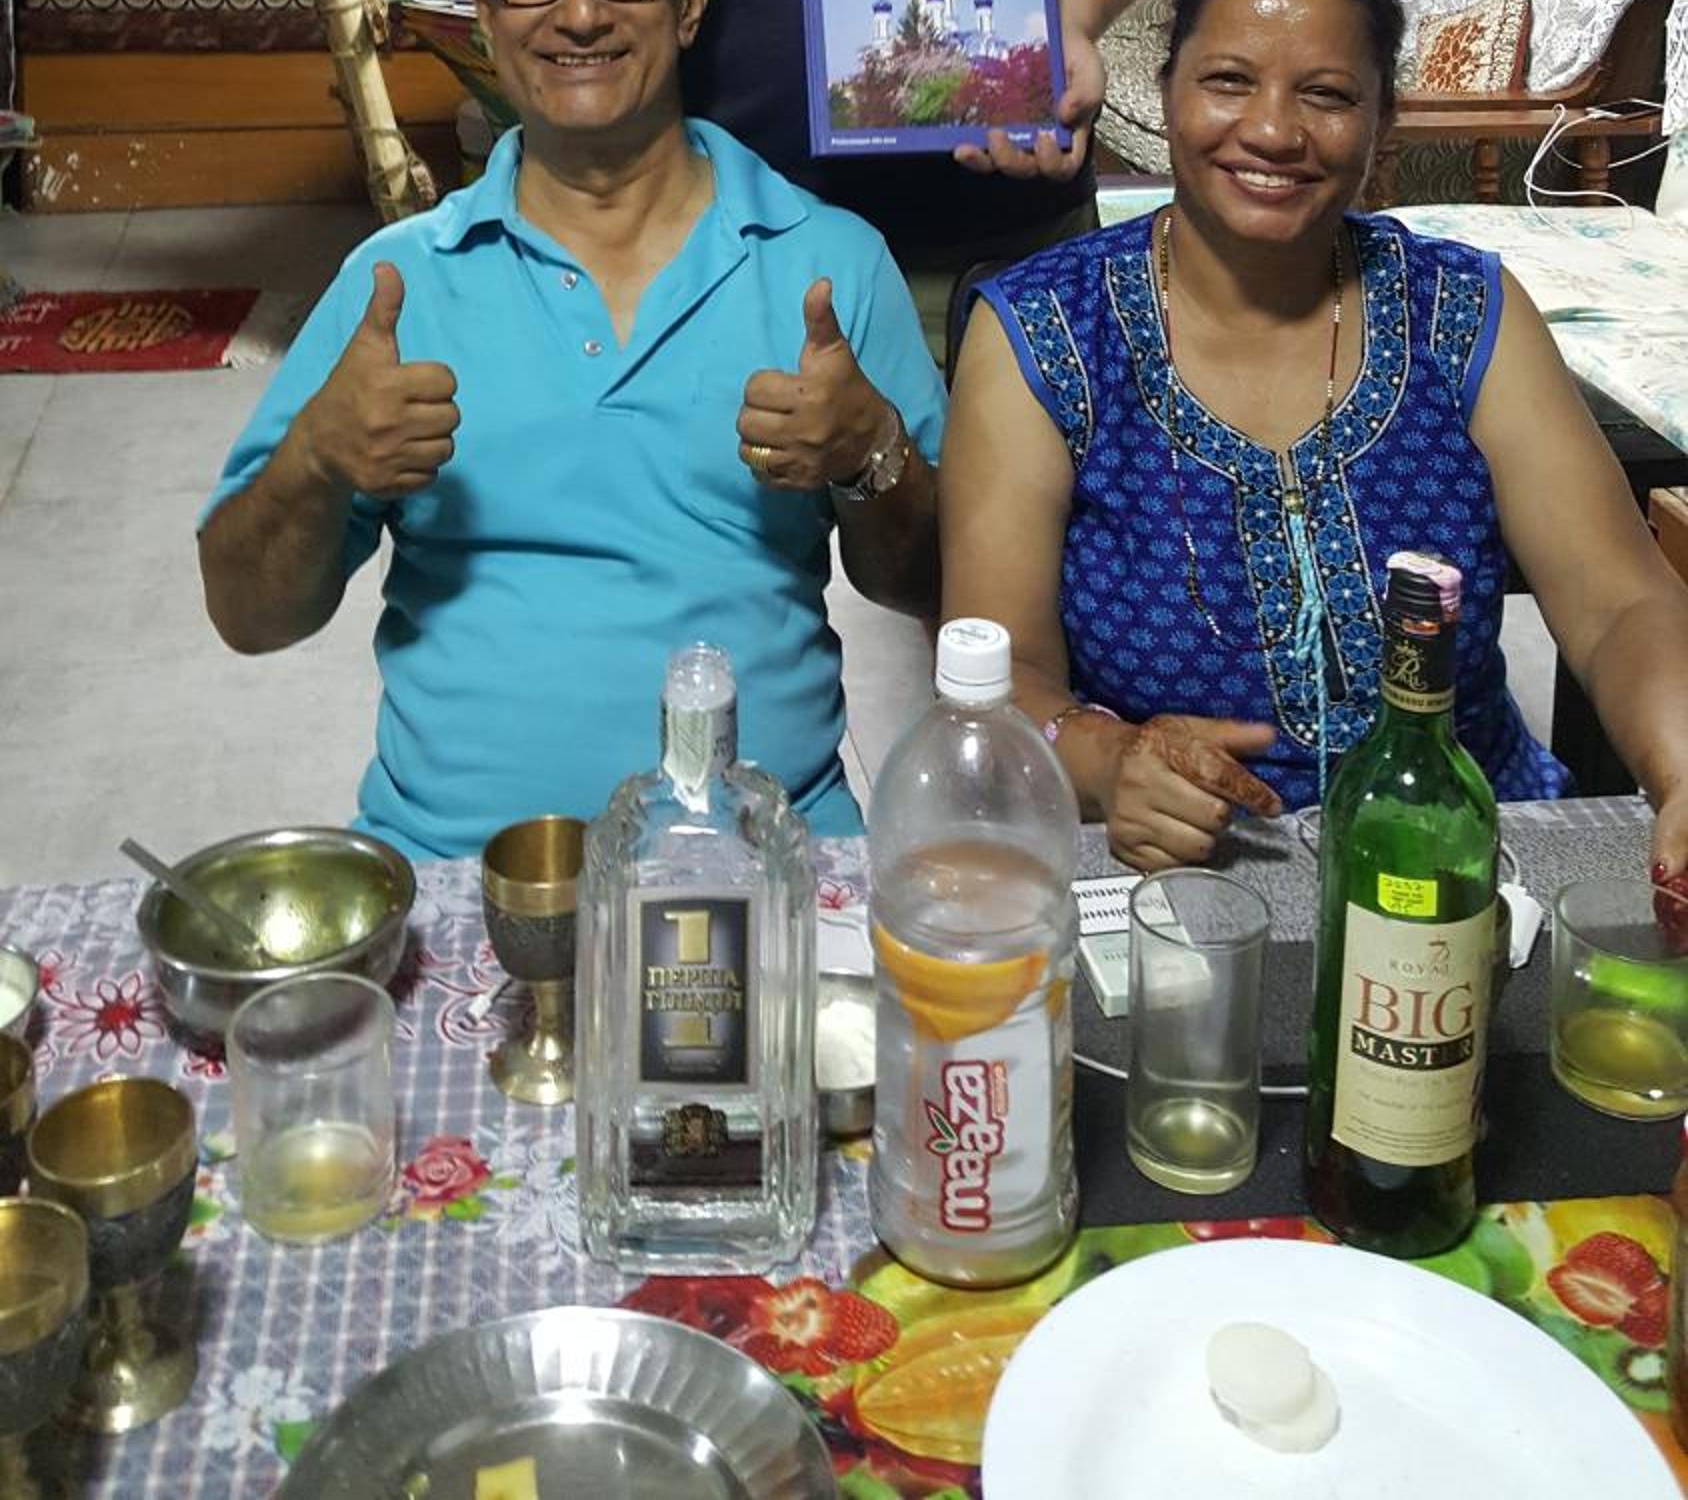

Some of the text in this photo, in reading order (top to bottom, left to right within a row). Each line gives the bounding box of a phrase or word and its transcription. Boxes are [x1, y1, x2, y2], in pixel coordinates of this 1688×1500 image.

[1353, 972, 1473, 1038] BIG
[1354, 1031, 1473, 1066] MASTR
[942, 1060, 1004, 1231] maaza
